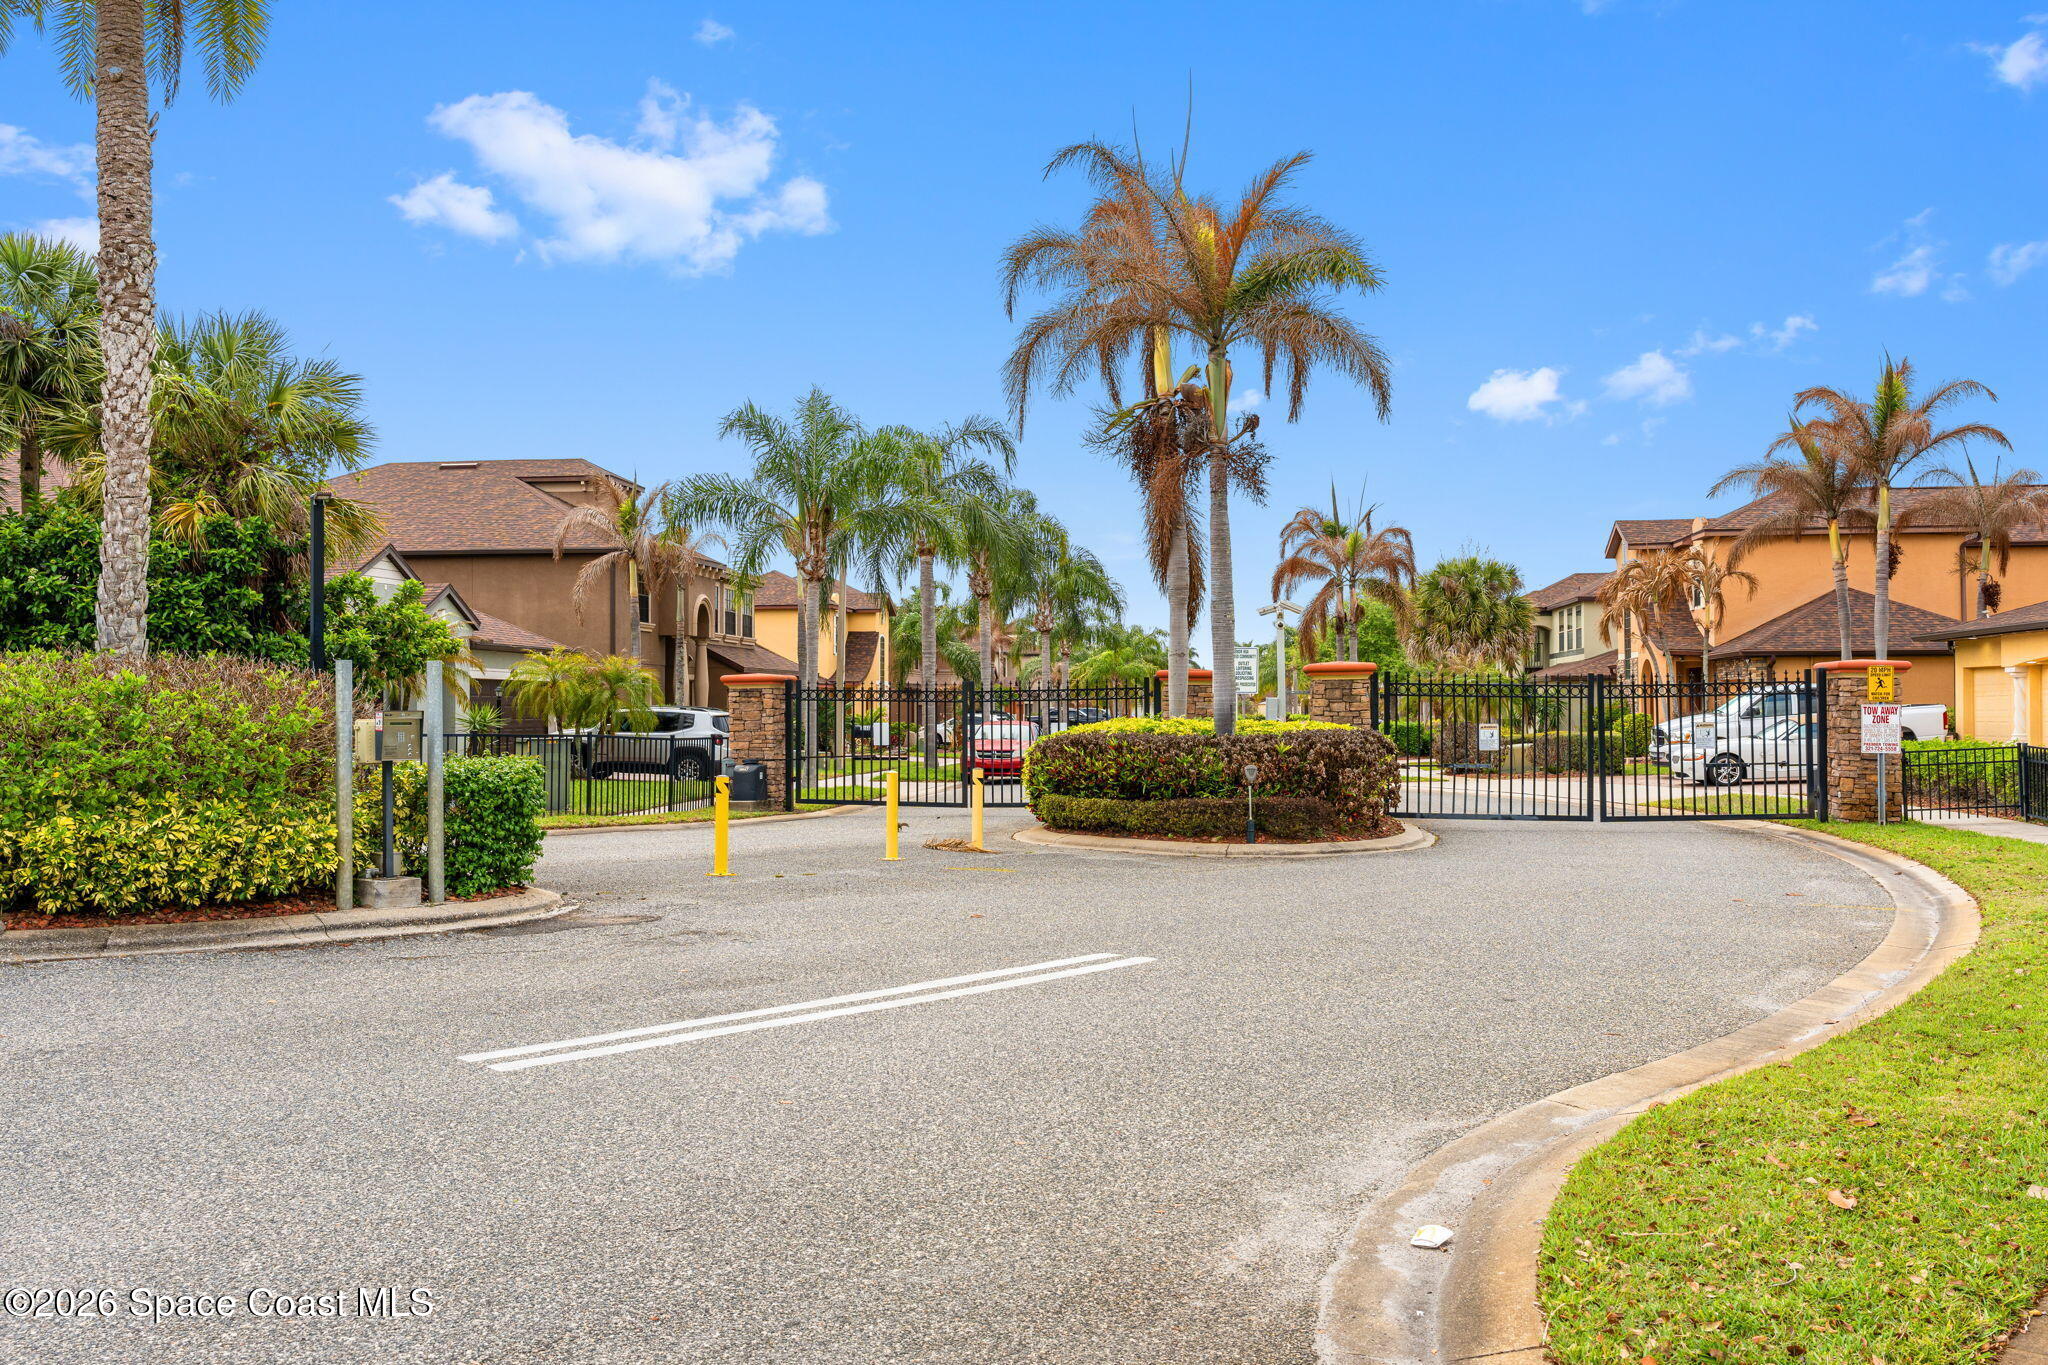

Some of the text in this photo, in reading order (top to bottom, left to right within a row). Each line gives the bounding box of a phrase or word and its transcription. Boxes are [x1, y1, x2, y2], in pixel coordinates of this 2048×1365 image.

[1863, 706, 1899, 715] TOW AWAY
[1872, 715, 1890, 724] ZONE
